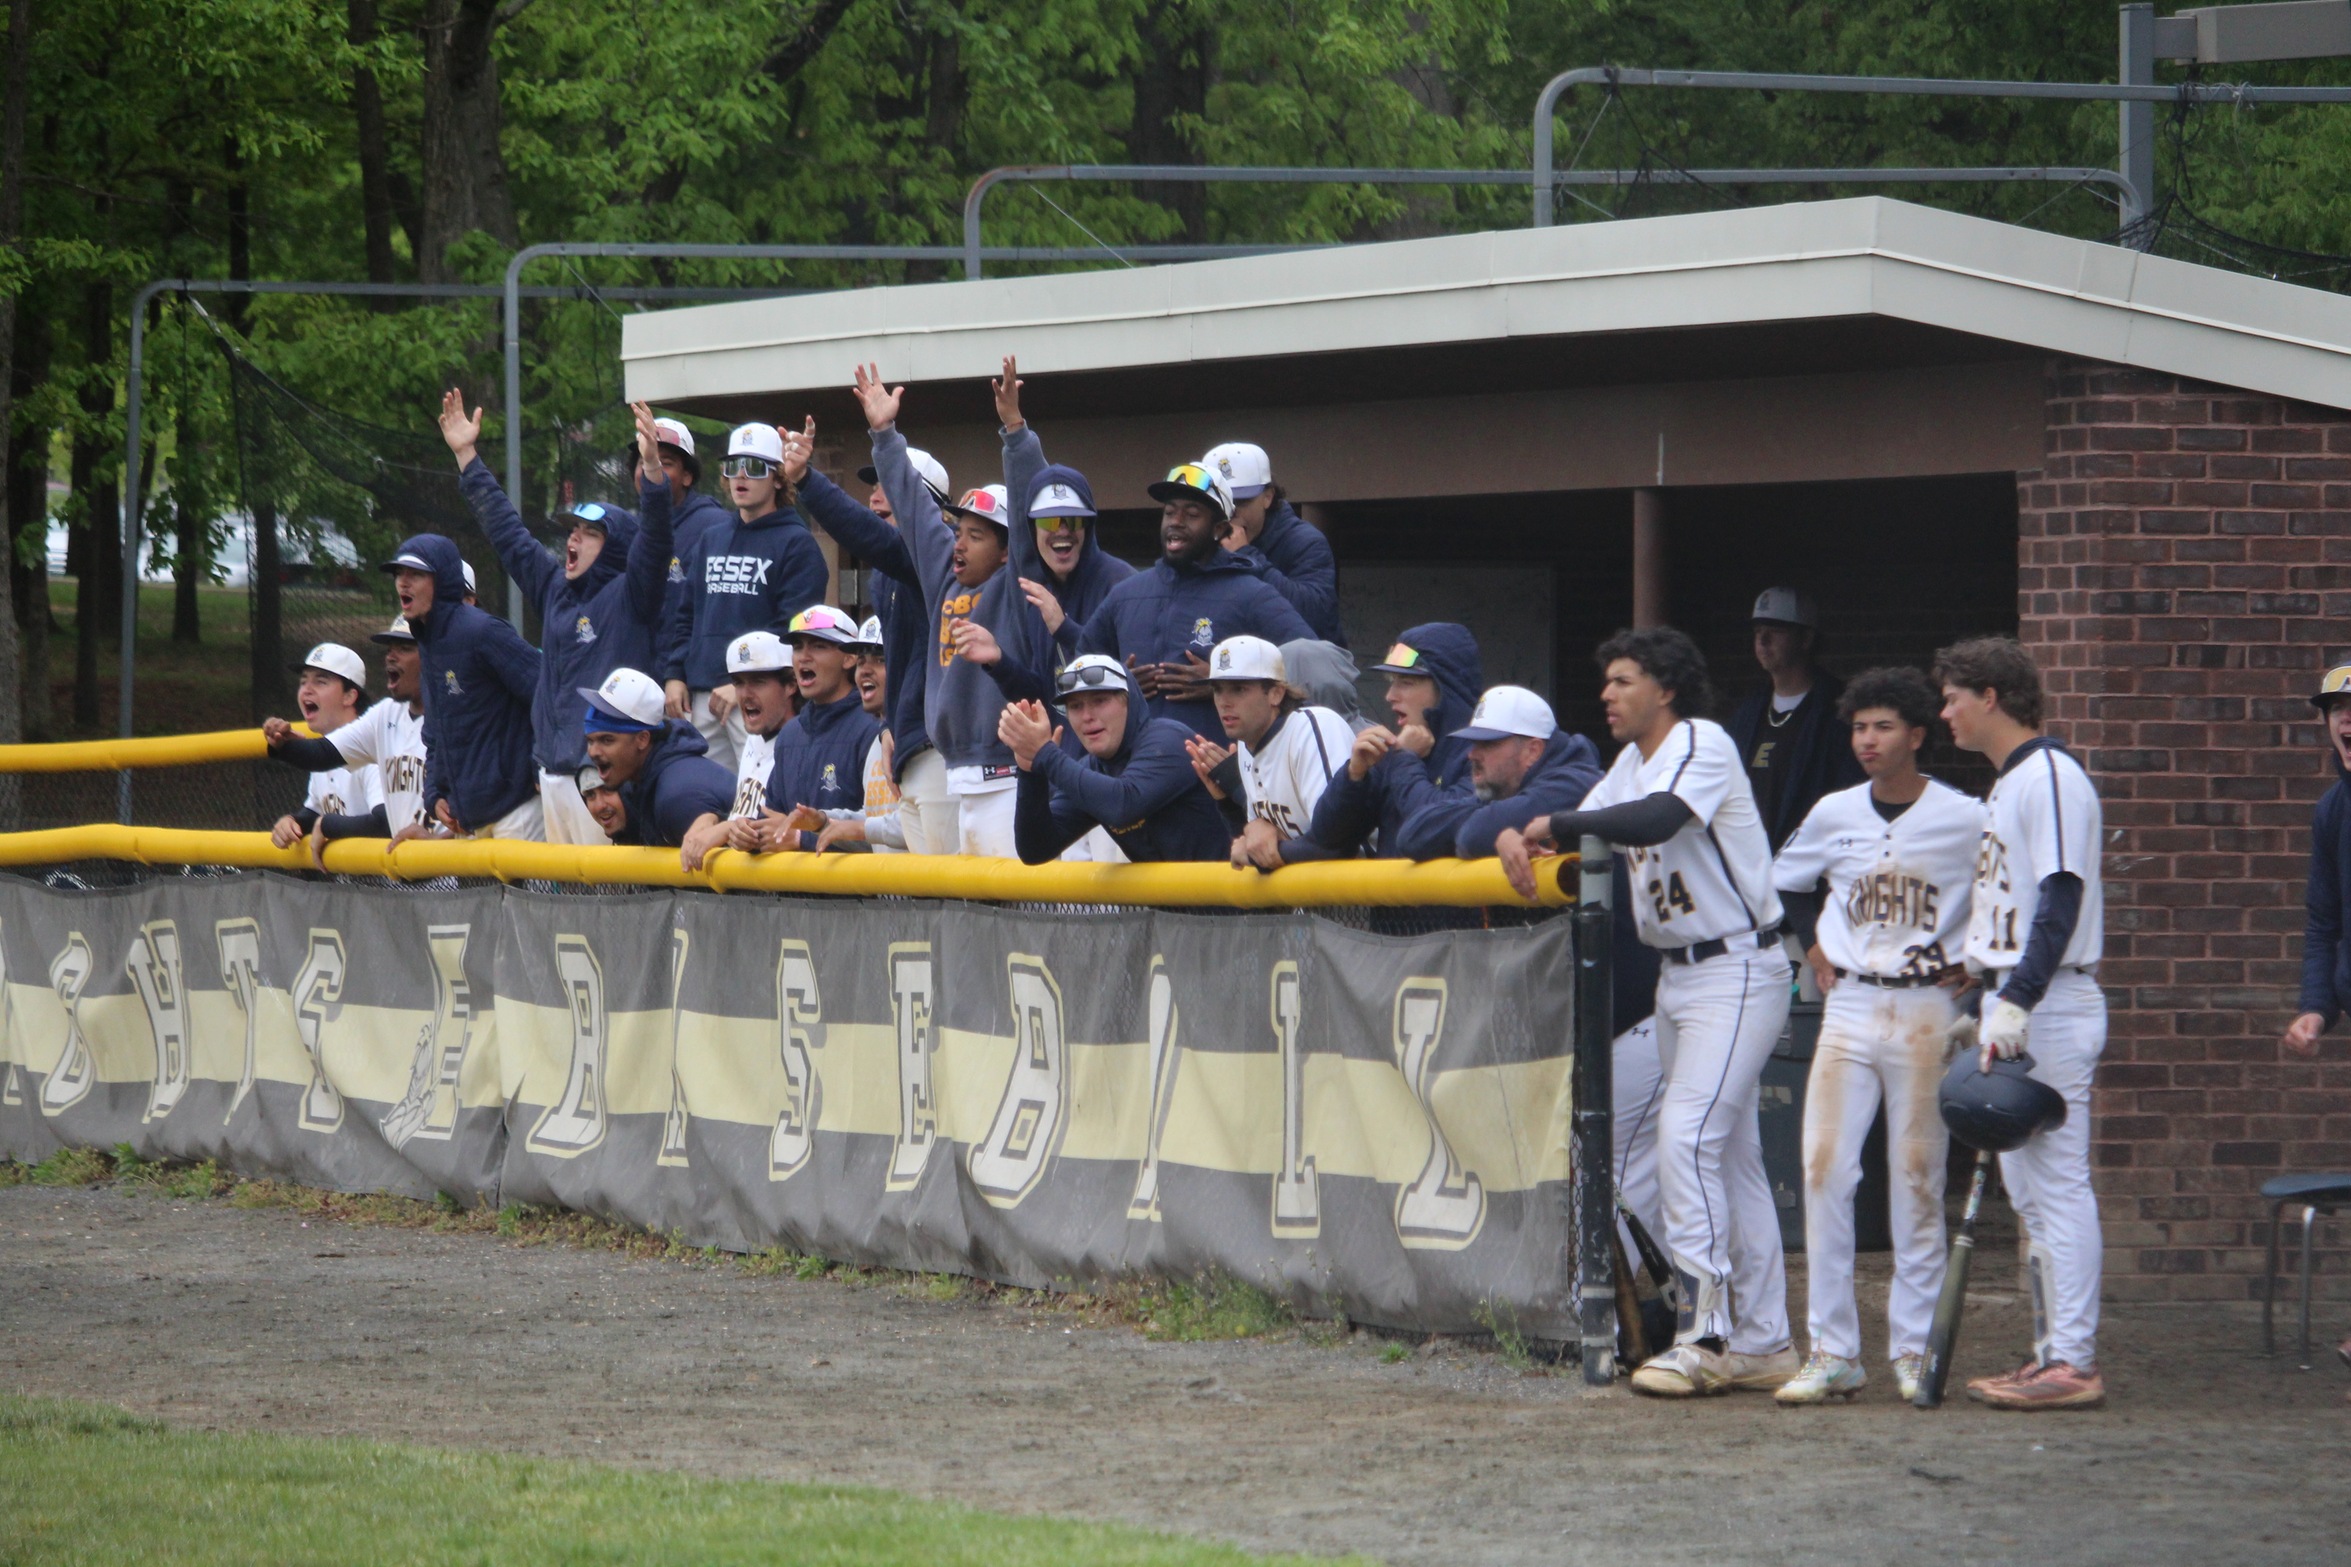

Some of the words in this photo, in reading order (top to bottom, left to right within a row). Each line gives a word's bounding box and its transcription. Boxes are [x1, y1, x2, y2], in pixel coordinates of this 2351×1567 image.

[705, 555, 774, 585] ESSEX
[706, 582, 759, 596] BASEBALL
[1648, 870, 1697, 924] 24
[1847, 874, 1939, 934] KNIGHTS
[1988, 905, 2017, 951] 11
[1901, 940, 1951, 978] 39
[524, 927, 1488, 1251] BSEBLL
